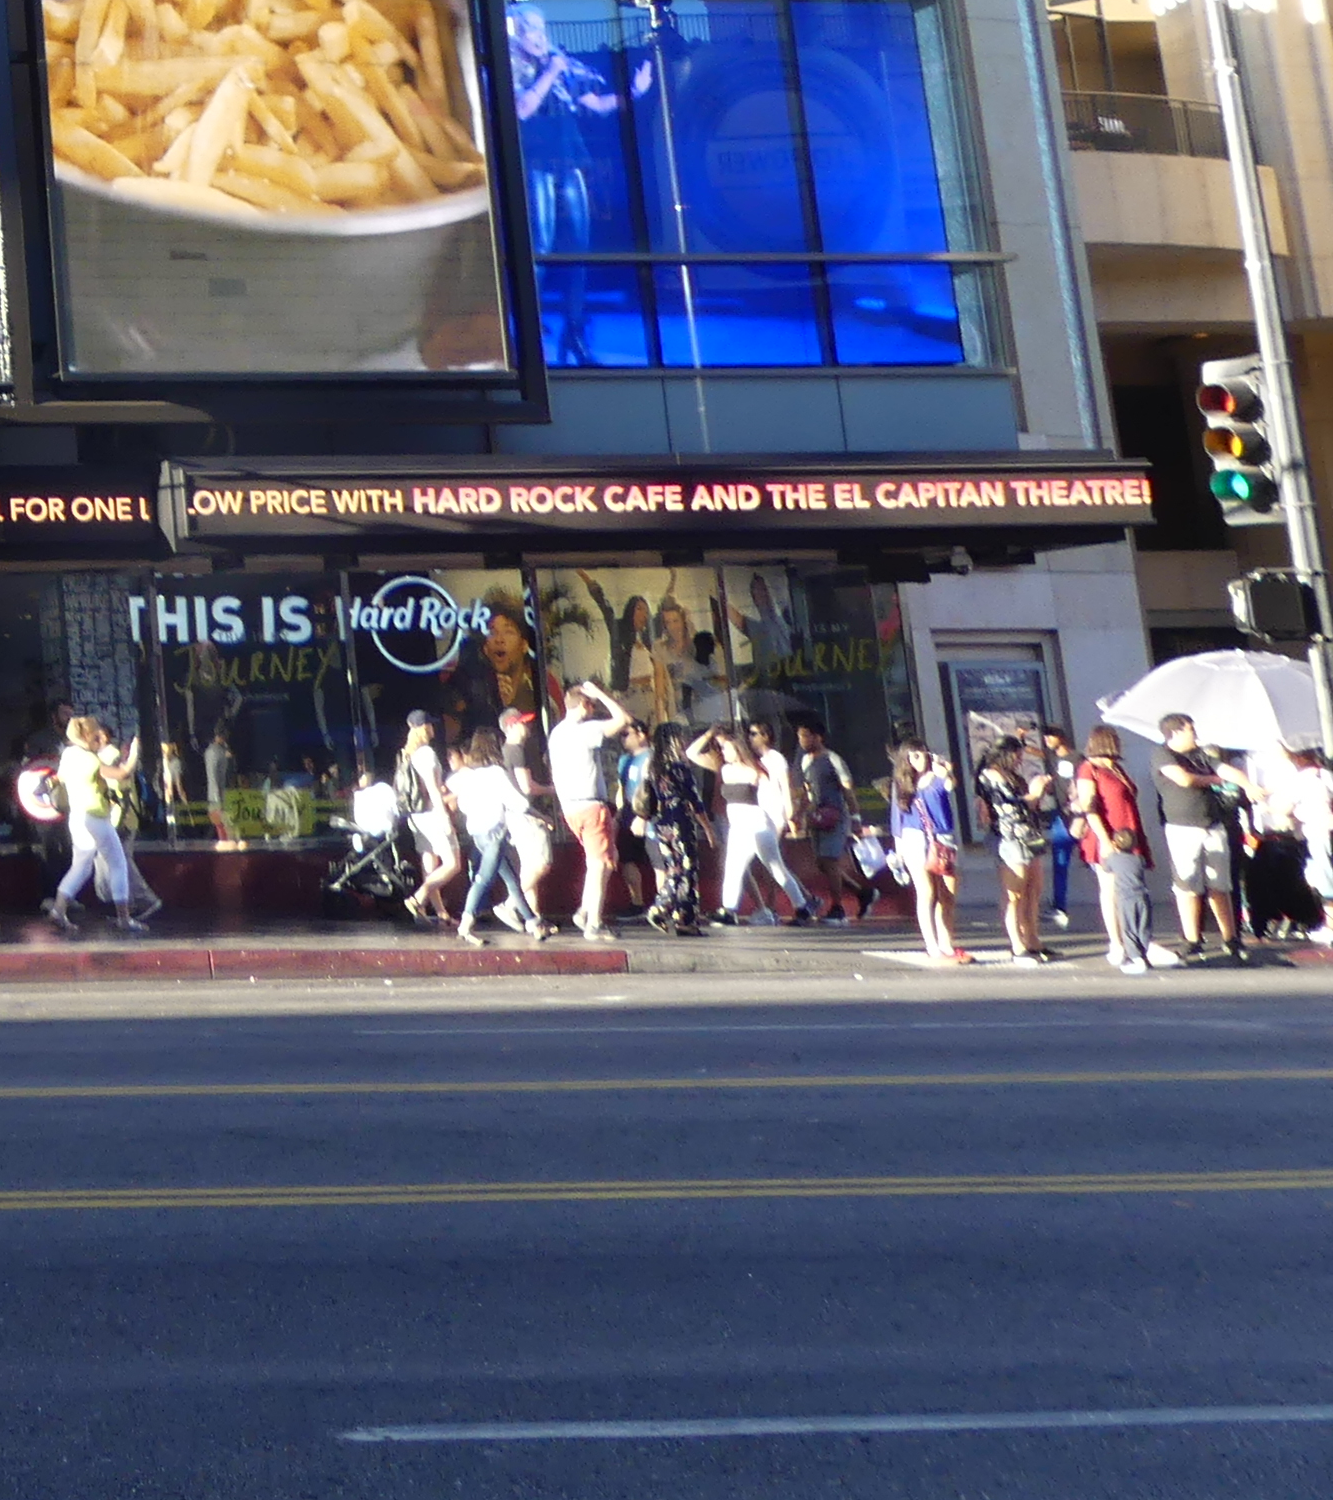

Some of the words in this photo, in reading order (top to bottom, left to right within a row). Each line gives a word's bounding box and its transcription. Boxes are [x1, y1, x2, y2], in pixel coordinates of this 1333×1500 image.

[10, 496, 66, 522] FOR
[71, 496, 134, 522] ONE
[249, 488, 329, 515] PRICE
[332, 487, 404, 514] WITH
[412, 486, 502, 515] HARD
[508, 485, 599, 514] ROCK
[603, 484, 683, 513] CAFE
[690, 483, 762, 512] AND
[765, 481, 828, 511] THE
[833, 481, 872, 510] EL
[874, 479, 1007, 510] CAPITAN
[1010, 478, 1154, 507] THEATRE!
[129, 595, 246, 645] THIS
[261, 595, 314, 645] IS
[419, 595, 492, 638] Rock
[173, 646, 332, 695] JOURNEY
